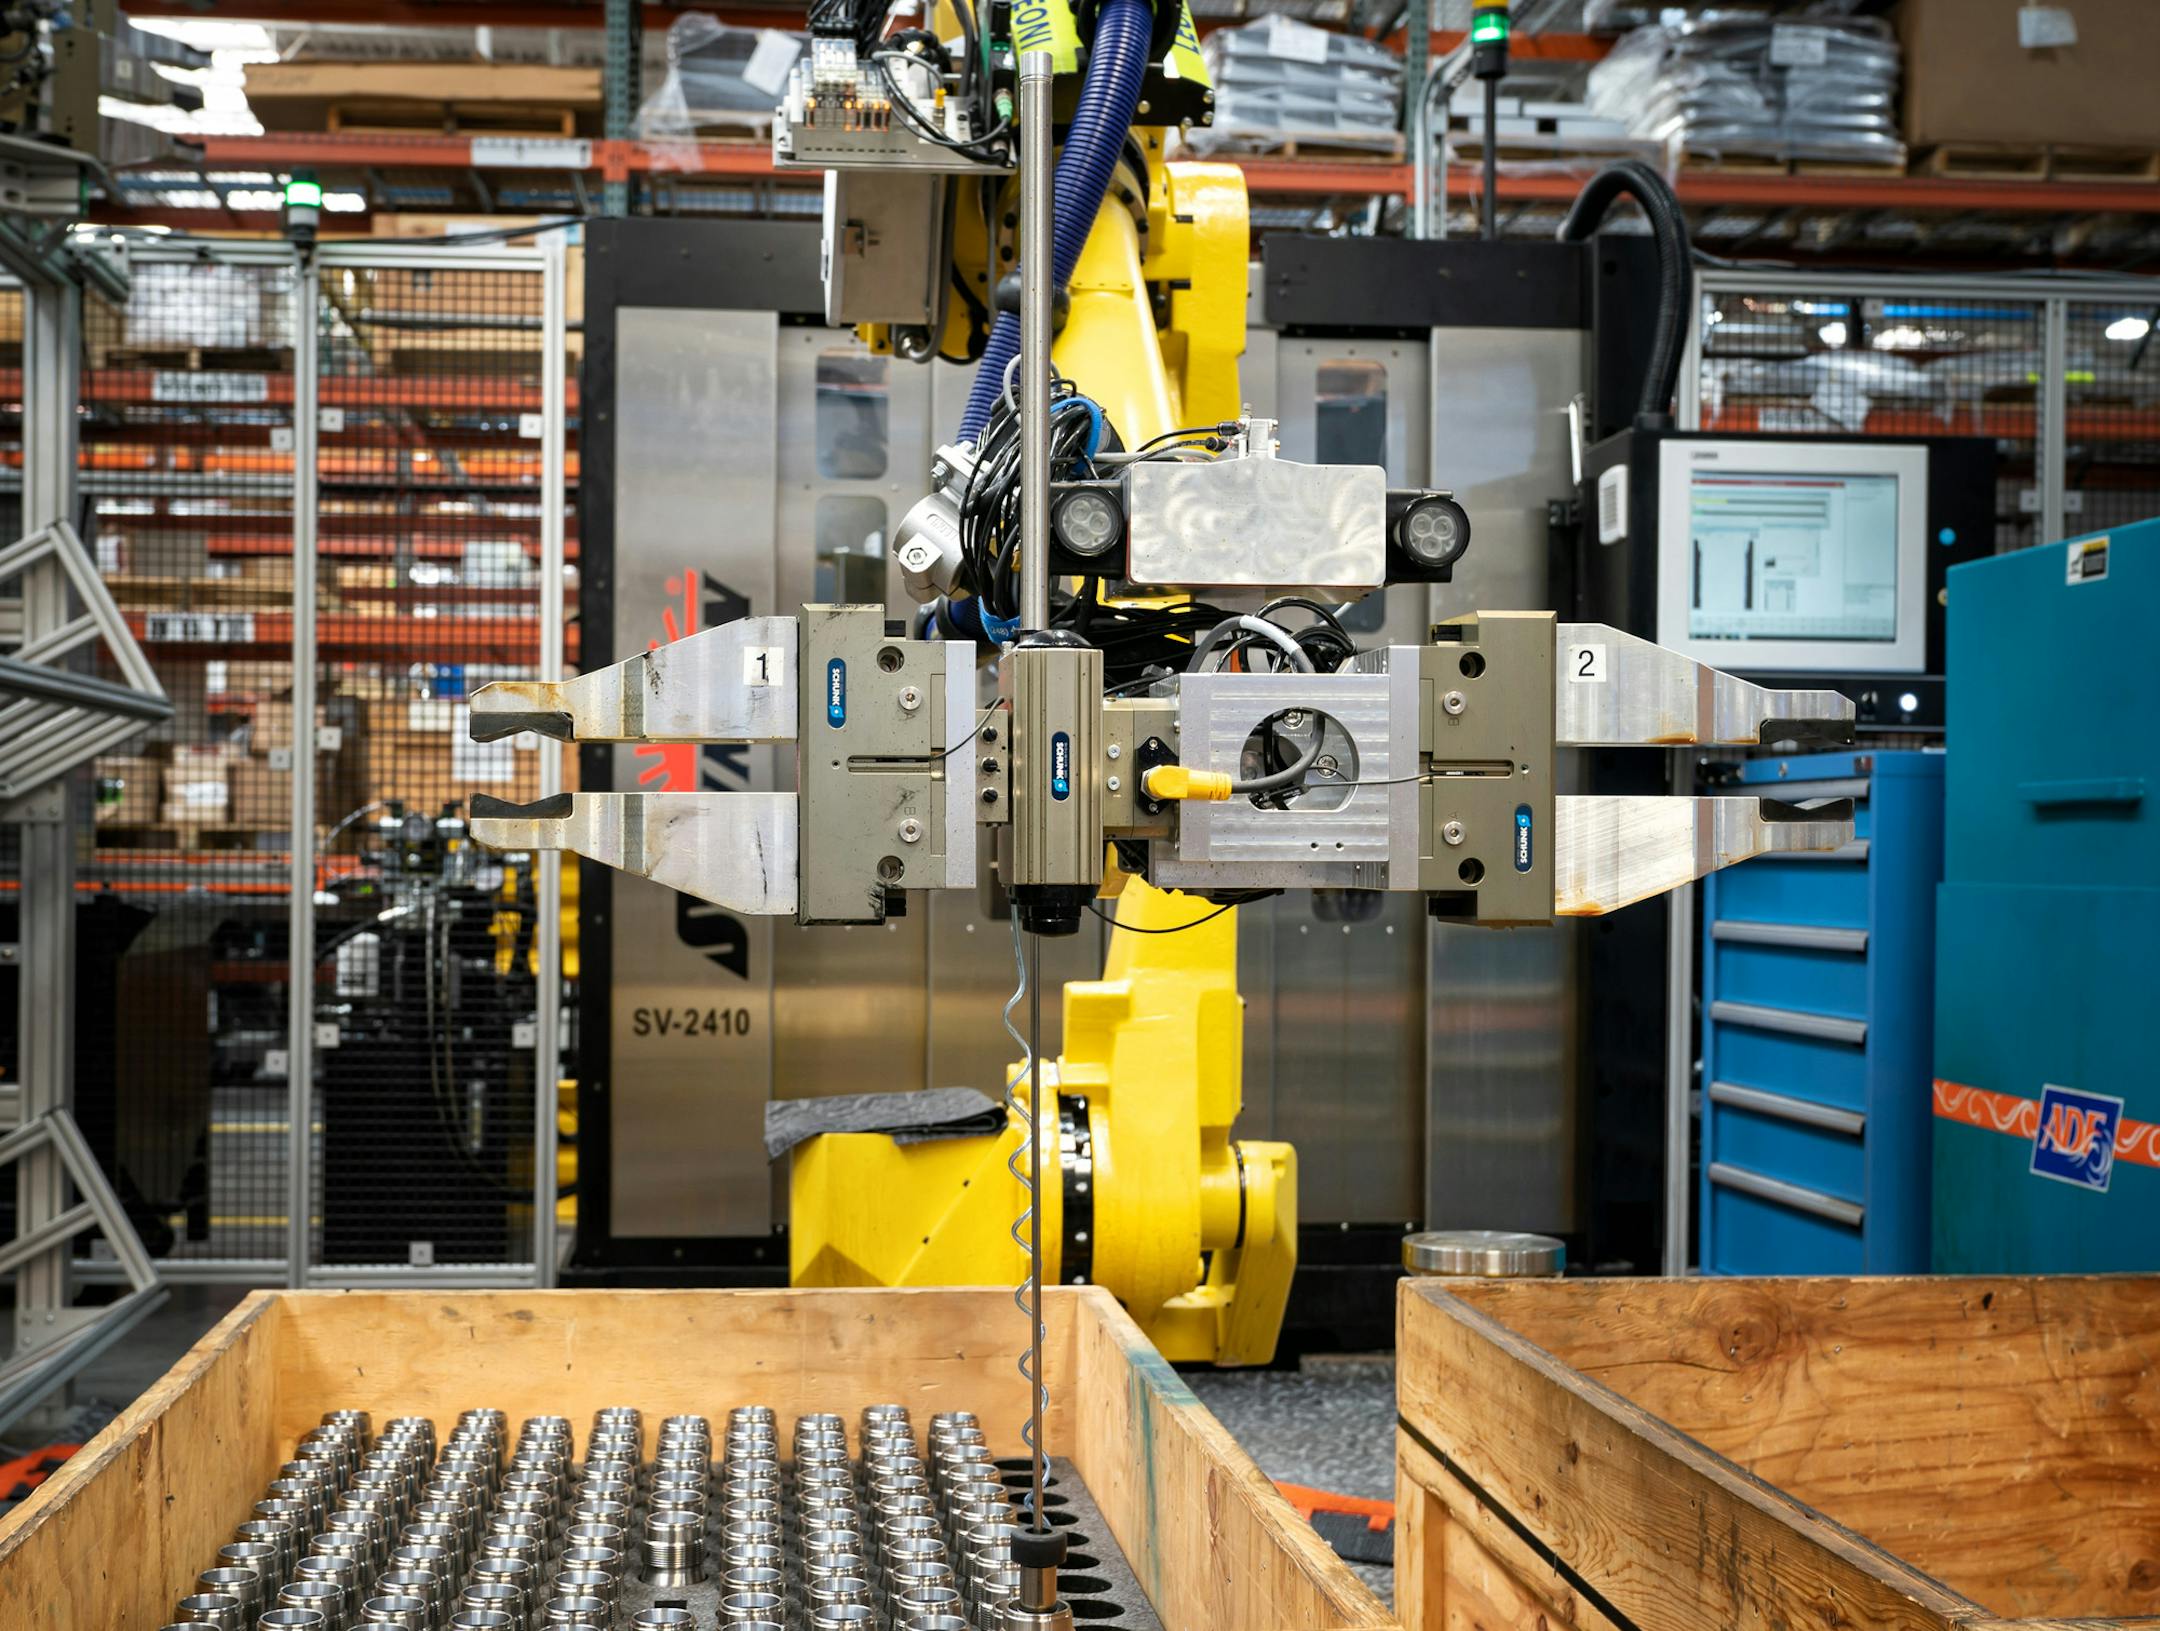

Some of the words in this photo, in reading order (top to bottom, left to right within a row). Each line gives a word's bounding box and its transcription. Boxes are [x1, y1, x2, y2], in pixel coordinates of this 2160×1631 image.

[1011, 0, 1053, 50] EONI
[757, 653, 766, 679] 1
[1578, 650, 1595, 677] 2
[832, 668, 840, 706] SCHUNK
[1056, 742, 1064, 779] SCHUNK
[1520, 826, 1528, 864] SCHUNK
[633, 1007, 751, 1037] SV-2410
